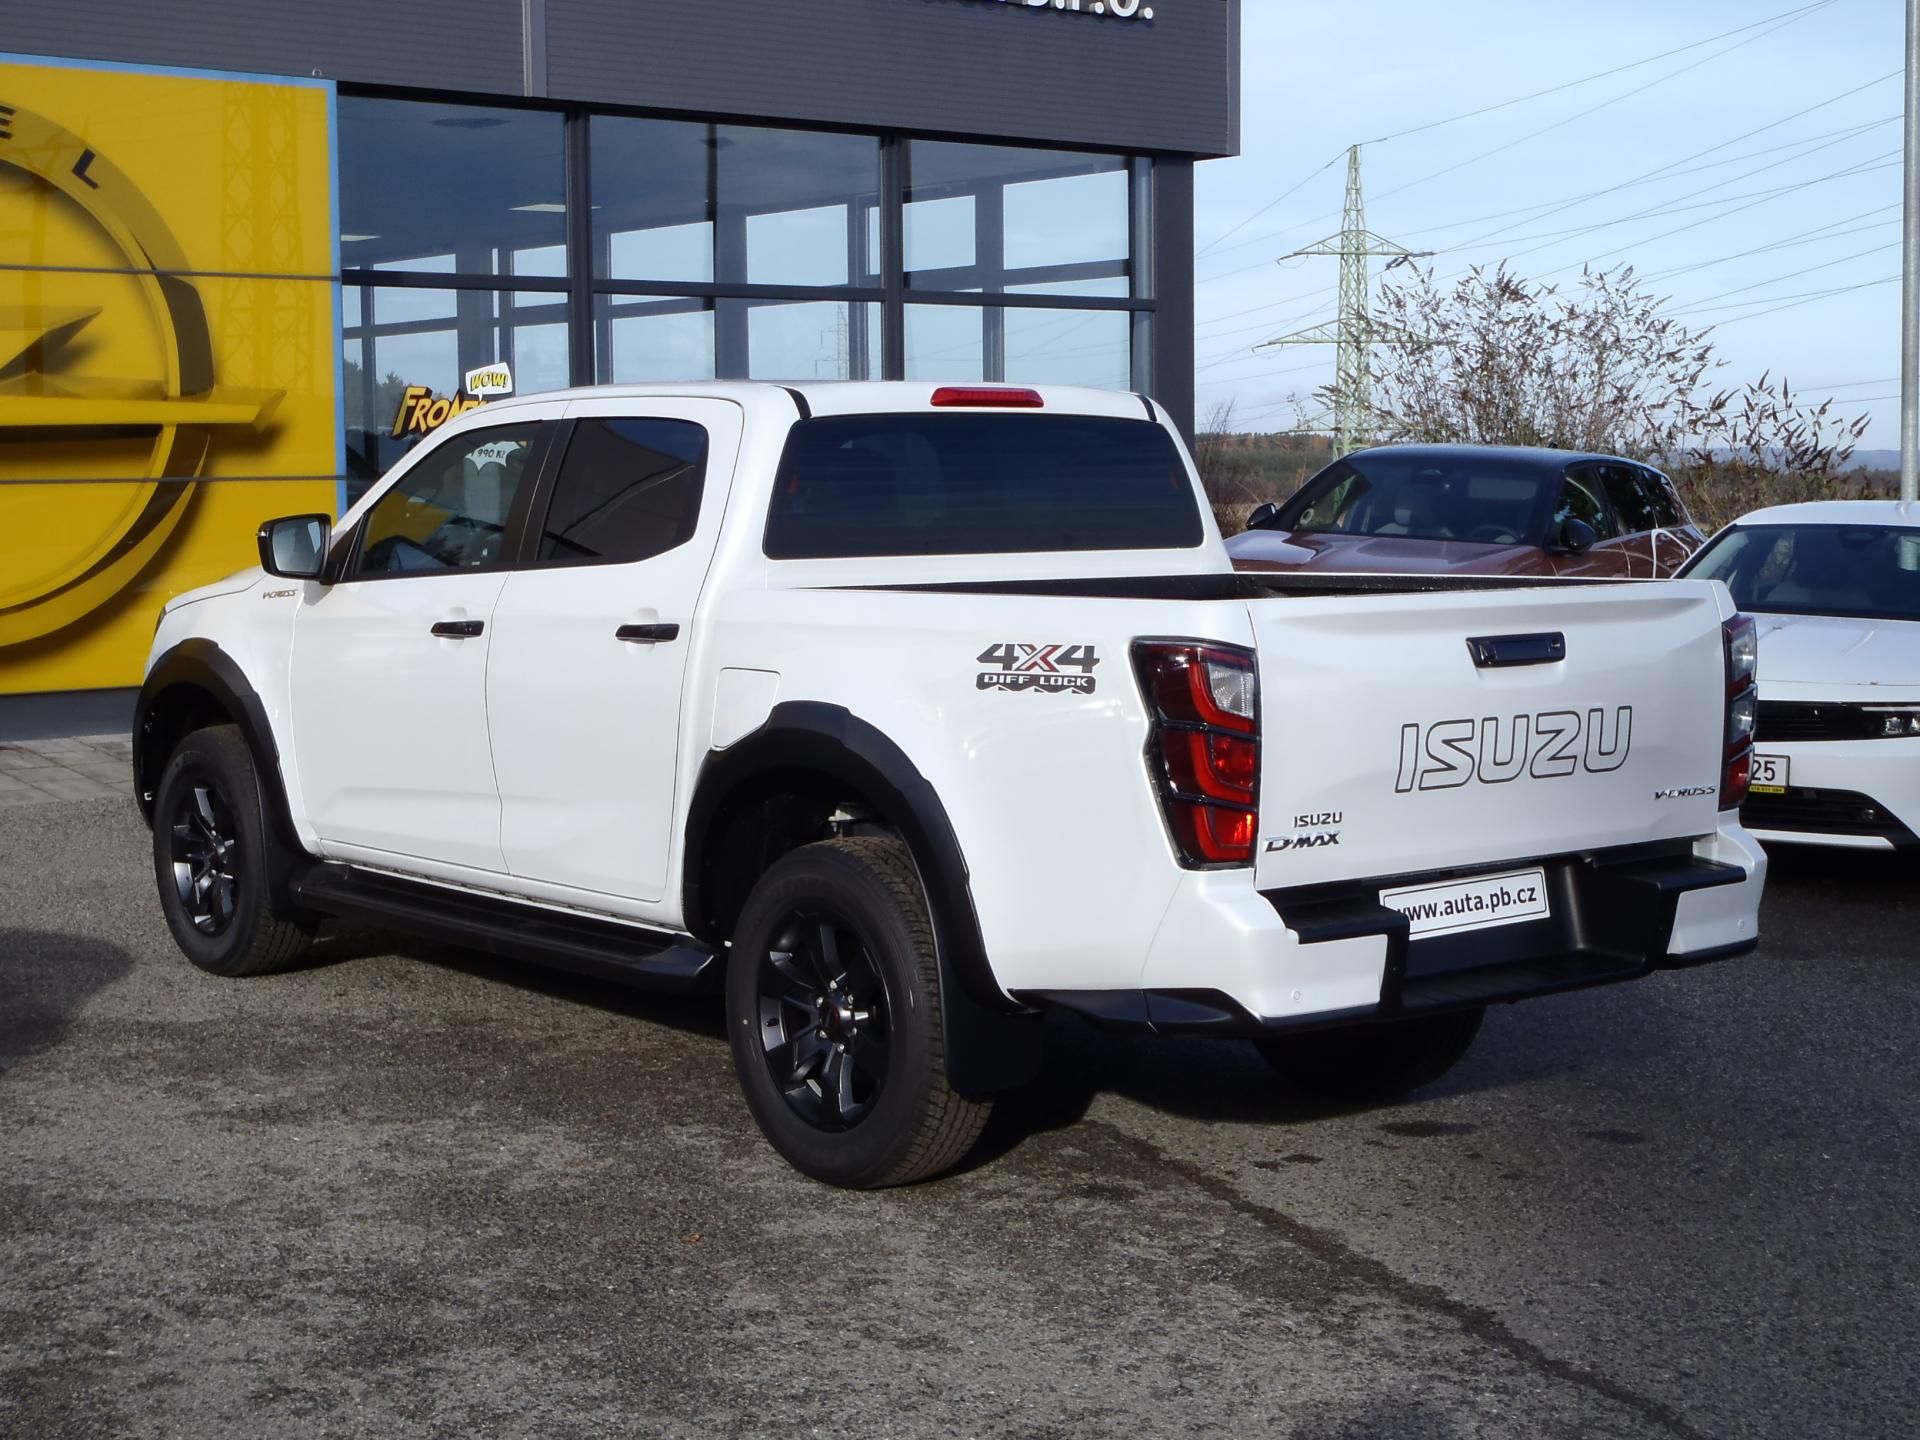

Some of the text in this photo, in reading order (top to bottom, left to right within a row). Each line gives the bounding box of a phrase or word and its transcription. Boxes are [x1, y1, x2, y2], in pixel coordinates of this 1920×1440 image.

[470, 370, 508, 392] WOW!
[983, 674, 1089, 687] DIFF LOCK
[1394, 705, 1633, 794] ISUZU
[1752, 760, 1776, 781] 25
[1293, 811, 1343, 828] ISUZU
[1397, 886, 1537, 922] ww.auta.pb.cz
